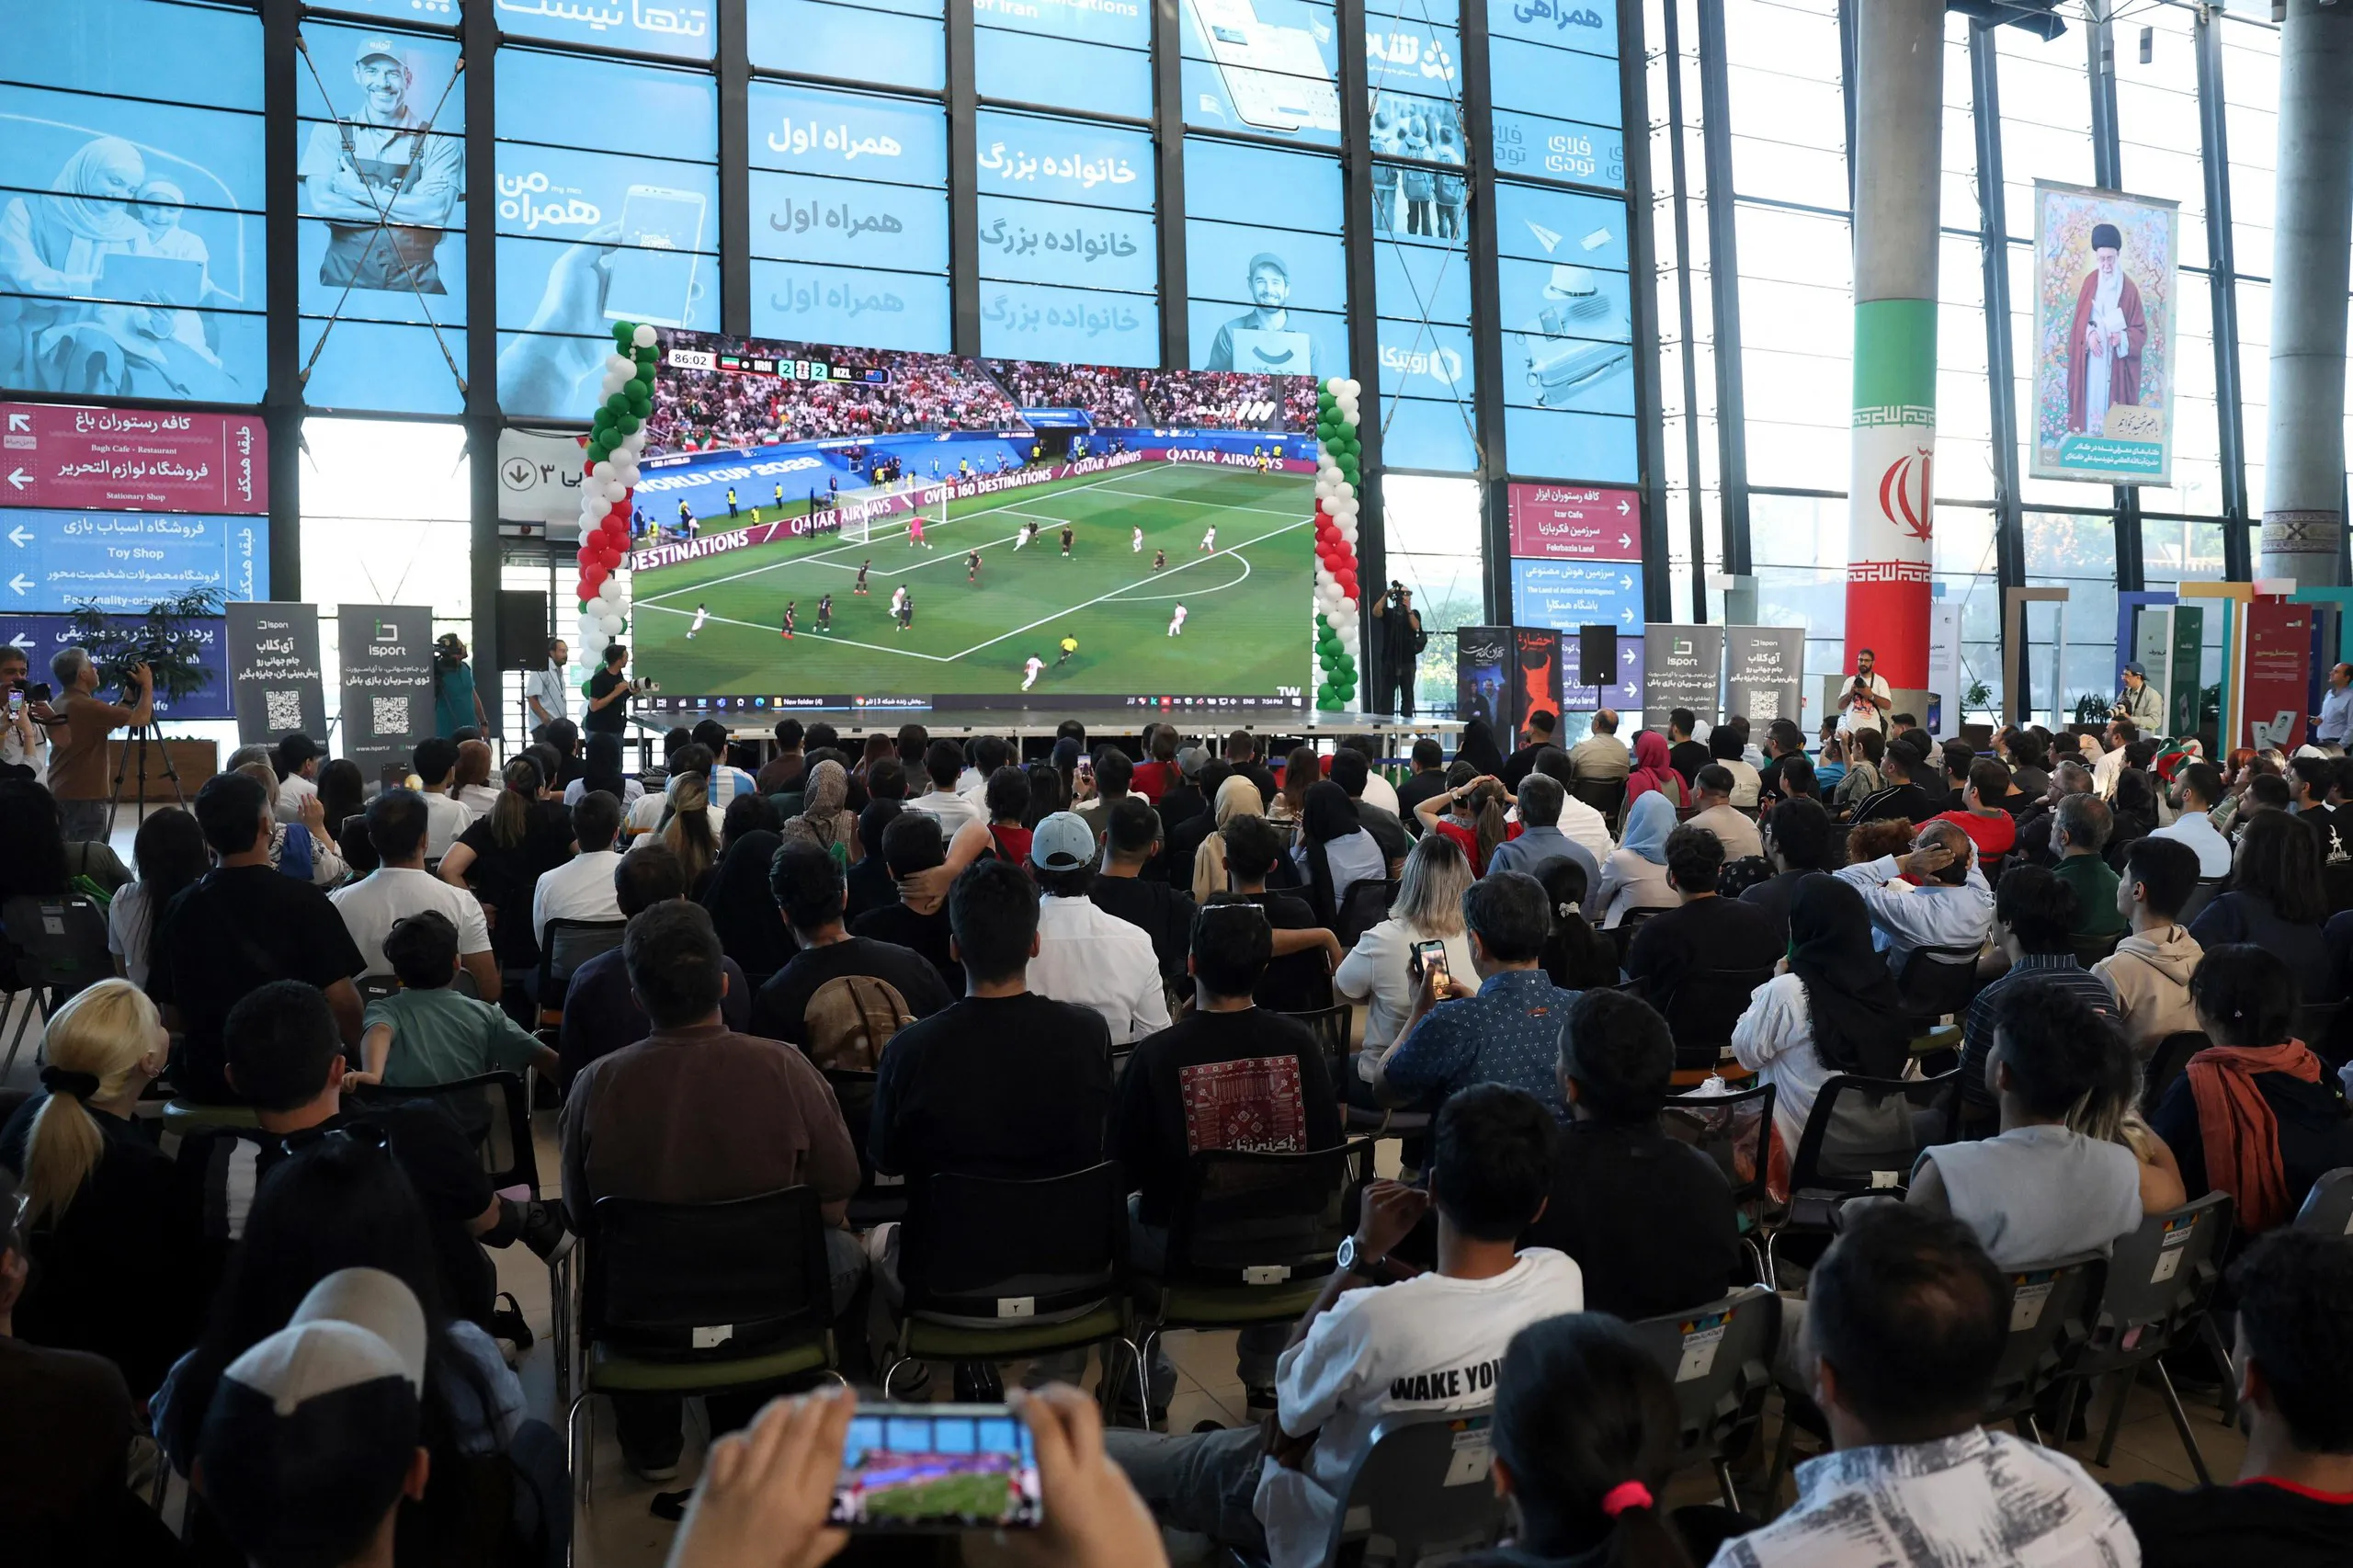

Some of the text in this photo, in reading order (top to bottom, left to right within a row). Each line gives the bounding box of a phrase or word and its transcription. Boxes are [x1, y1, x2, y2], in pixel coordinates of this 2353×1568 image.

[632, 5, 707, 36] تنها
[1515, 0, 1603, 29] همراهی
[767, 118, 902, 160] همراه اول
[1548, 135, 1592, 156] فلای
[978, 142, 1137, 187] خانواده بزرگ
[1545, 154, 1596, 176] تودی
[497, 172, 550, 196] من
[551, 186, 564, 196] my
[498, 194, 601, 231] همراه
[770, 199, 904, 238] همراه اول
[980, 218, 1138, 262] خانواده بزرگ
[771, 278, 904, 318] همراه اول
[982, 295, 1140, 337] خانواده بزرگ
[674, 354, 852, 379] 86:02 IRN 2 2 NZL
[1380, 345, 1428, 375] روبیکا
[1196, 403, 1232, 418] زنده
[75, 413, 191, 433] کافه رستوران باغ
[91, 444, 177, 455] Bagh Cafe Restaurant
[1166, 449, 1284, 471] QATAR AIRWAYS
[58, 460, 209, 482] فروشگاه لوازم التحریر
[236, 426, 255, 502] طبقه همکف
[540, 463, 555, 484] ۳
[633, 457, 824, 494] WORLD CUP 2026
[106, 492, 166, 502] Stationary Shop
[790, 512, 837, 534] QATAR
[840, 499, 892, 524] AIRWAYS
[924, 484, 955, 505] OVER
[957, 481, 974, 497] 160
[978, 467, 1051, 494] DESTINATIONS
[1074, 460, 1104, 476] QATAR
[1107, 449, 1142, 467] AIRWAYS
[1552, 489, 1583, 503] رستوران
[1584, 491, 1599, 501] کافه
[1554, 510, 1584, 519] Izar Cafe
[63, 517, 205, 540] فروشگاه اسباب بازی
[1570, 527, 1600, 538] سرزمین
[238, 528, 256, 558] طبقه
[1578, 544, 1595, 553] Land
[108, 548, 165, 560] Toy Shop
[126, 569, 178, 582] محصولات
[179, 571, 221, 585] فروشگاه
[1526, 566, 1615, 580] سرزمین هوش مصنوعی
[1573, 599, 1598, 612] باشگاه
[267, 620, 289, 631] isport
[369, 644, 406, 658] isport
[256, 658, 301, 668] جام جهانی رو
[238, 670, 256, 681] بگیر
[346, 676, 430, 687] توی جریان بازی باش
[797, 698, 814, 706] folder
[814, 698, 823, 706] (4)
[1582, 697, 1596, 705] land
[1390, 1370, 1461, 1401] WAKE
